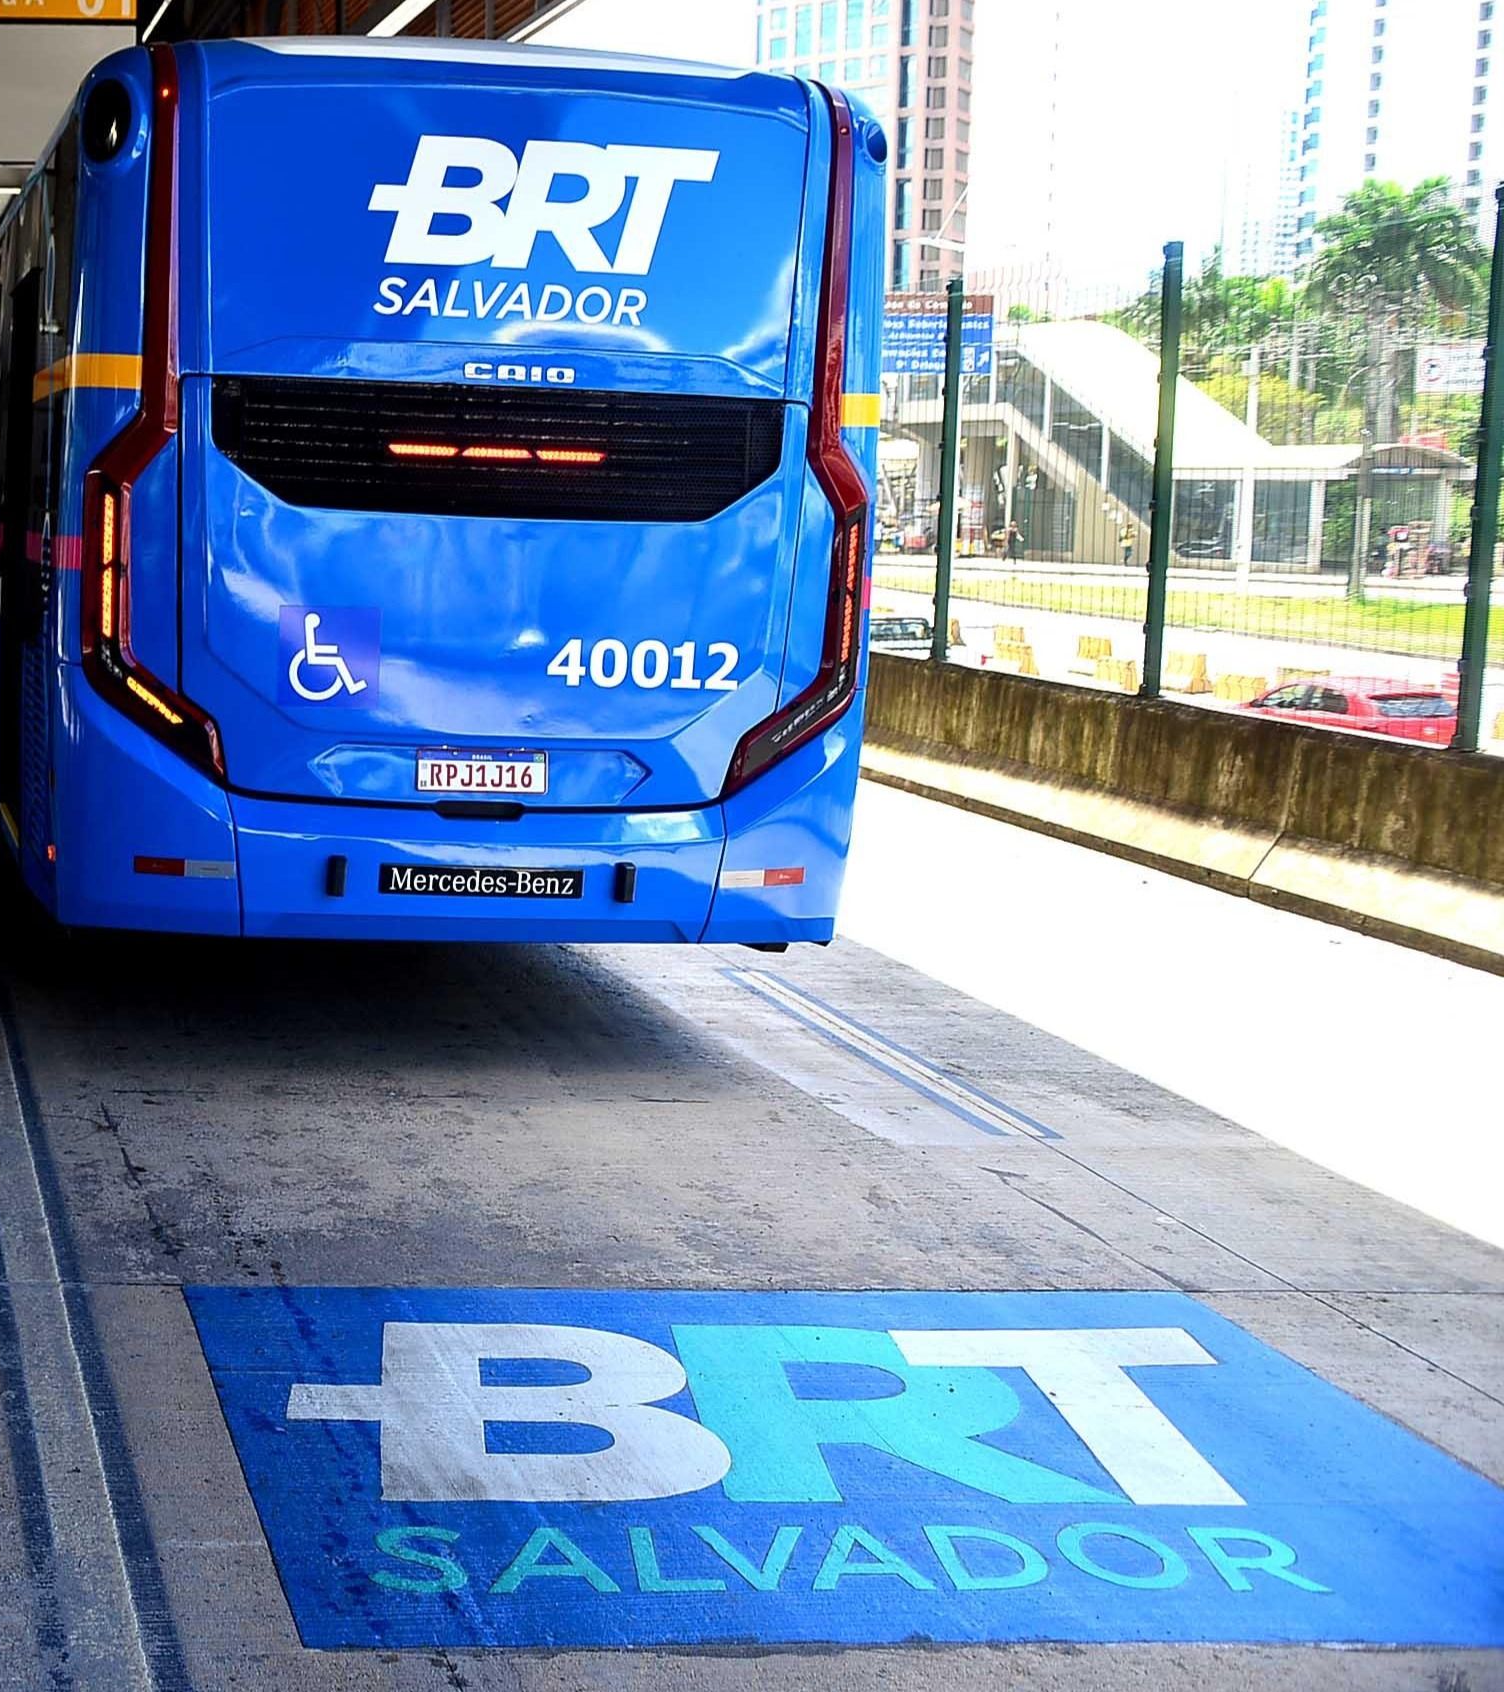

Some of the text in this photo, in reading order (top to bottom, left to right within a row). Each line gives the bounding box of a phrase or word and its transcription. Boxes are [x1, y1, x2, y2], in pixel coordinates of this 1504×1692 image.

[368, 135, 721, 276] BRT
[373, 277, 648, 326] SALVADOR
[547, 638, 740, 691] 40012
[430, 763, 533, 788] RPJ1J16
[391, 867, 574, 896] Mercedes-Benz
[286, 1322, 1247, 1507] BRT
[370, 1524, 1334, 1596] SALVADOR
